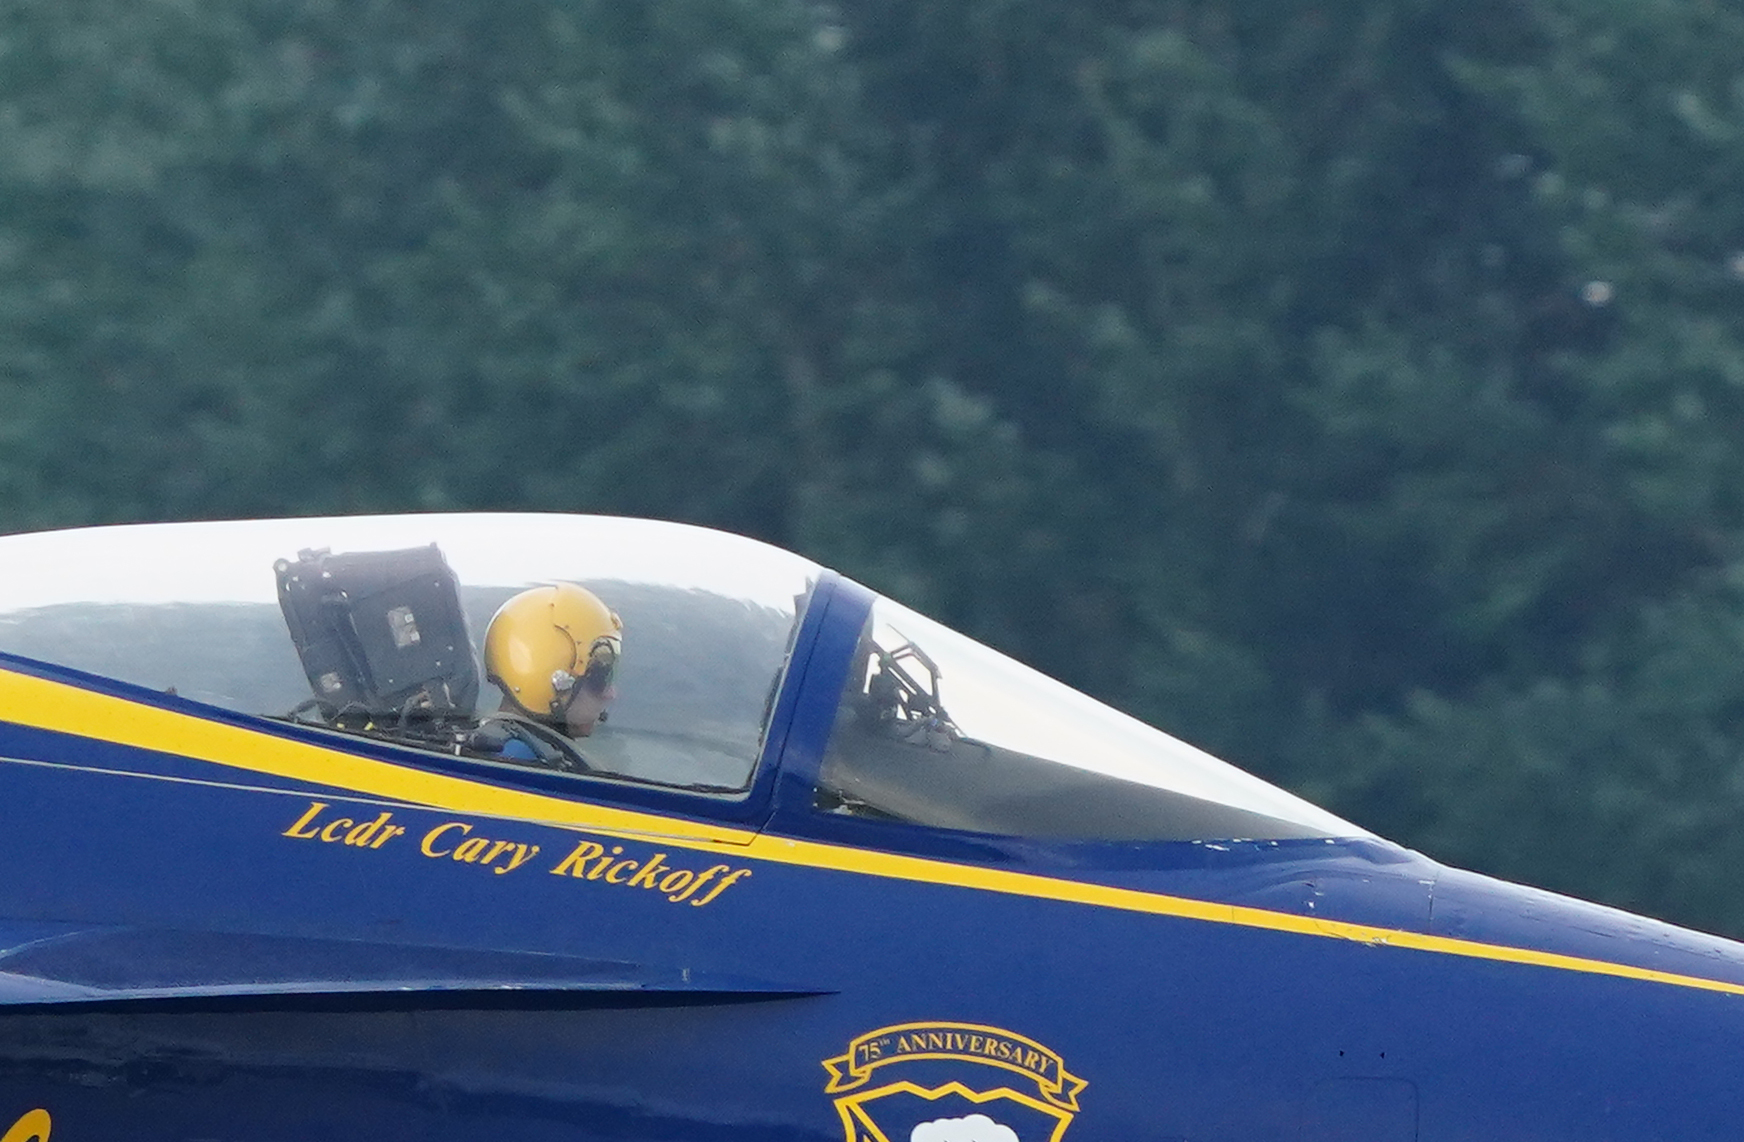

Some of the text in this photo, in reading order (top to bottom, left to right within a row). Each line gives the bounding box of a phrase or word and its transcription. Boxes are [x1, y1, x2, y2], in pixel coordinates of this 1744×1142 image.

[283, 801, 753, 907] Lcdr Cary Rickoff
[896, 1032, 1056, 1074] ANNIVERSARY
